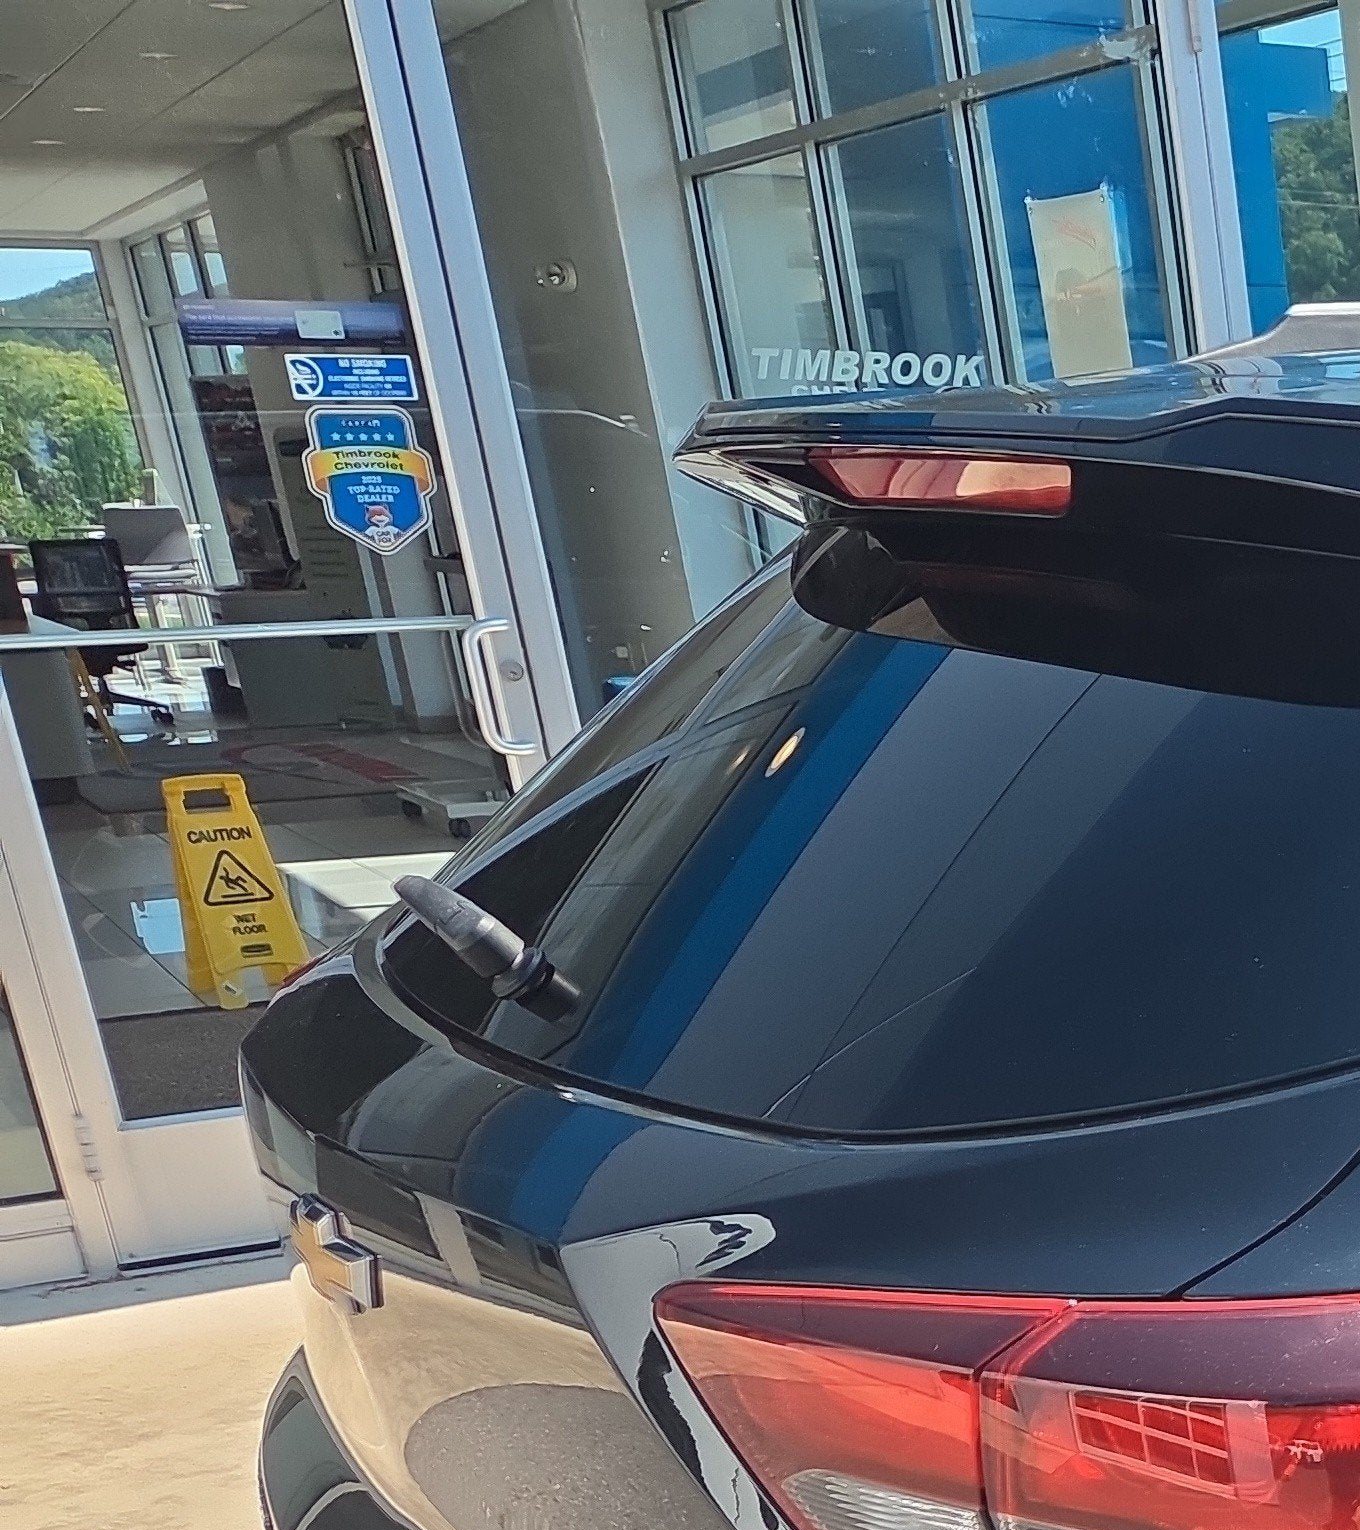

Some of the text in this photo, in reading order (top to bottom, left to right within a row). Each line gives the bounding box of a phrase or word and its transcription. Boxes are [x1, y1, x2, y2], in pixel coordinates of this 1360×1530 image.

[751, 348, 984, 388] TIMBROOK
[333, 449, 400, 460] Timbrook
[334, 461, 404, 471] Chevrolet
[186, 826, 253, 845] CAUTION
[232, 913, 257, 923] WET
[232, 924, 269, 936] FLOOR
